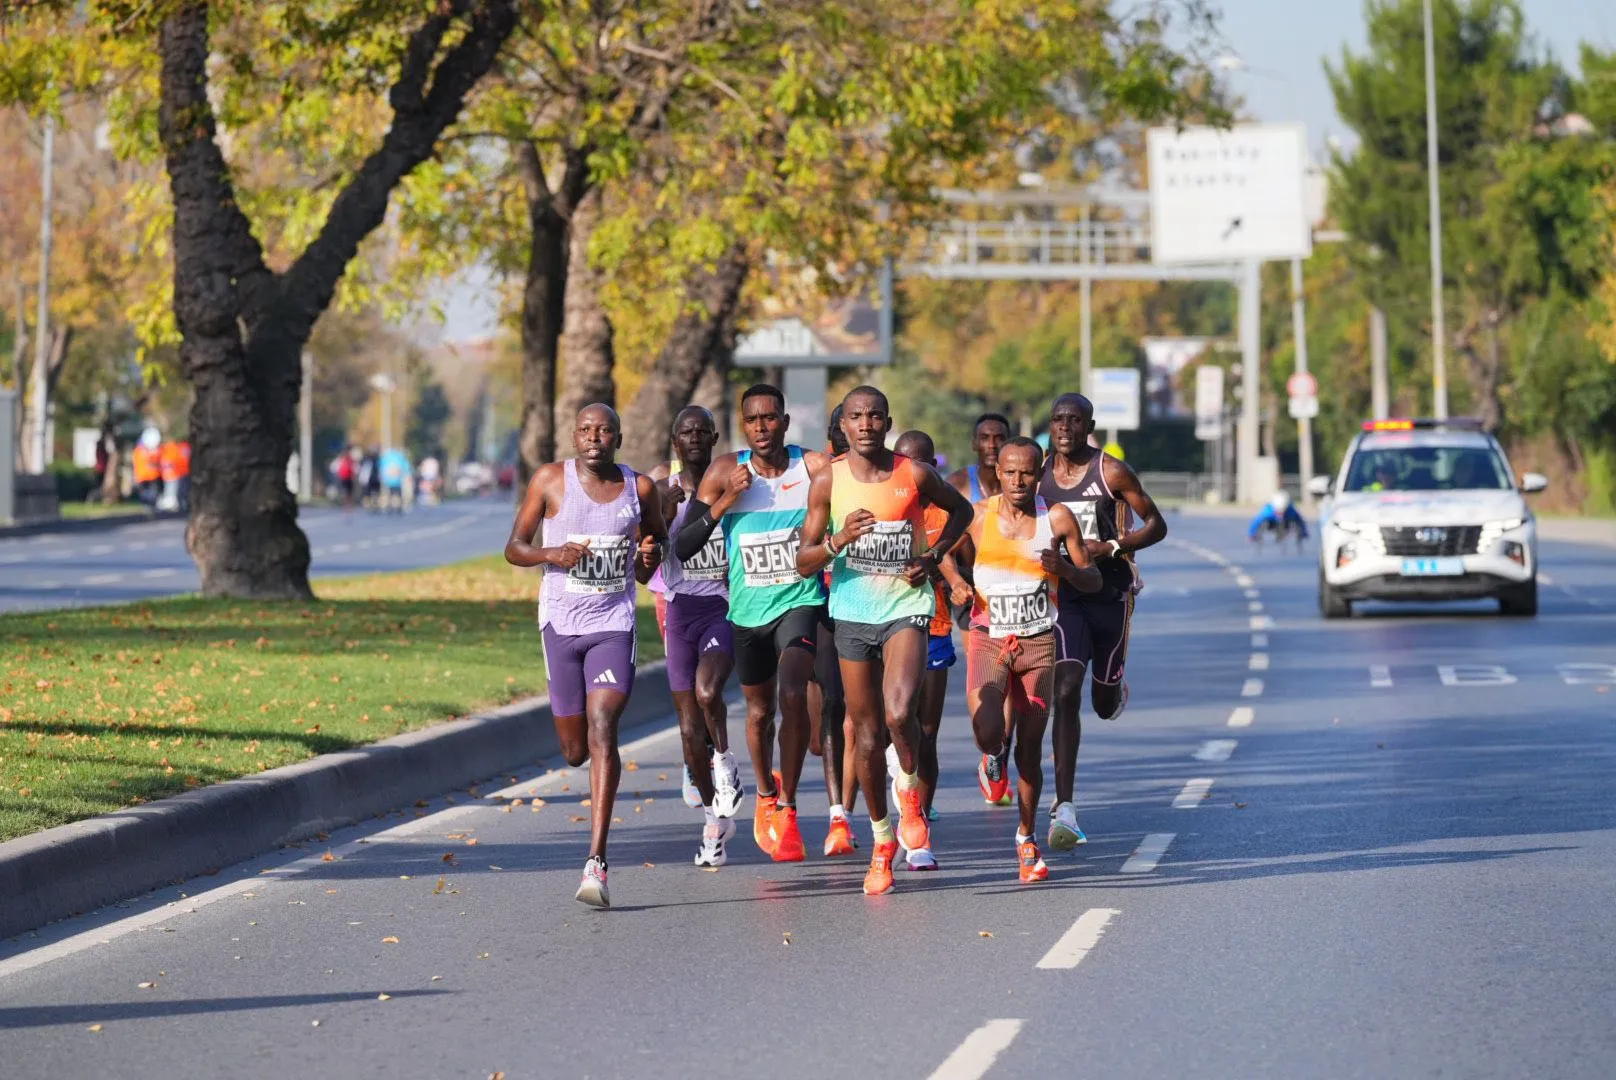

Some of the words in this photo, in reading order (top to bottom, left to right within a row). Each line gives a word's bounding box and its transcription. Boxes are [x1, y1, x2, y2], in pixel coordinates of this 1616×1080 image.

[904, 523, 913, 532] 91
[848, 532, 912, 561] CHRISTOPHER
[851, 559, 876, 567] ISTANBUL
[571, 579, 595, 587] ISTANBUL
[596, 579, 623, 587] MARATHON
[989, 592, 1048, 624] SUFARO
[910, 615, 928, 628] 361
[1019, 619, 1047, 629] MARATHON
